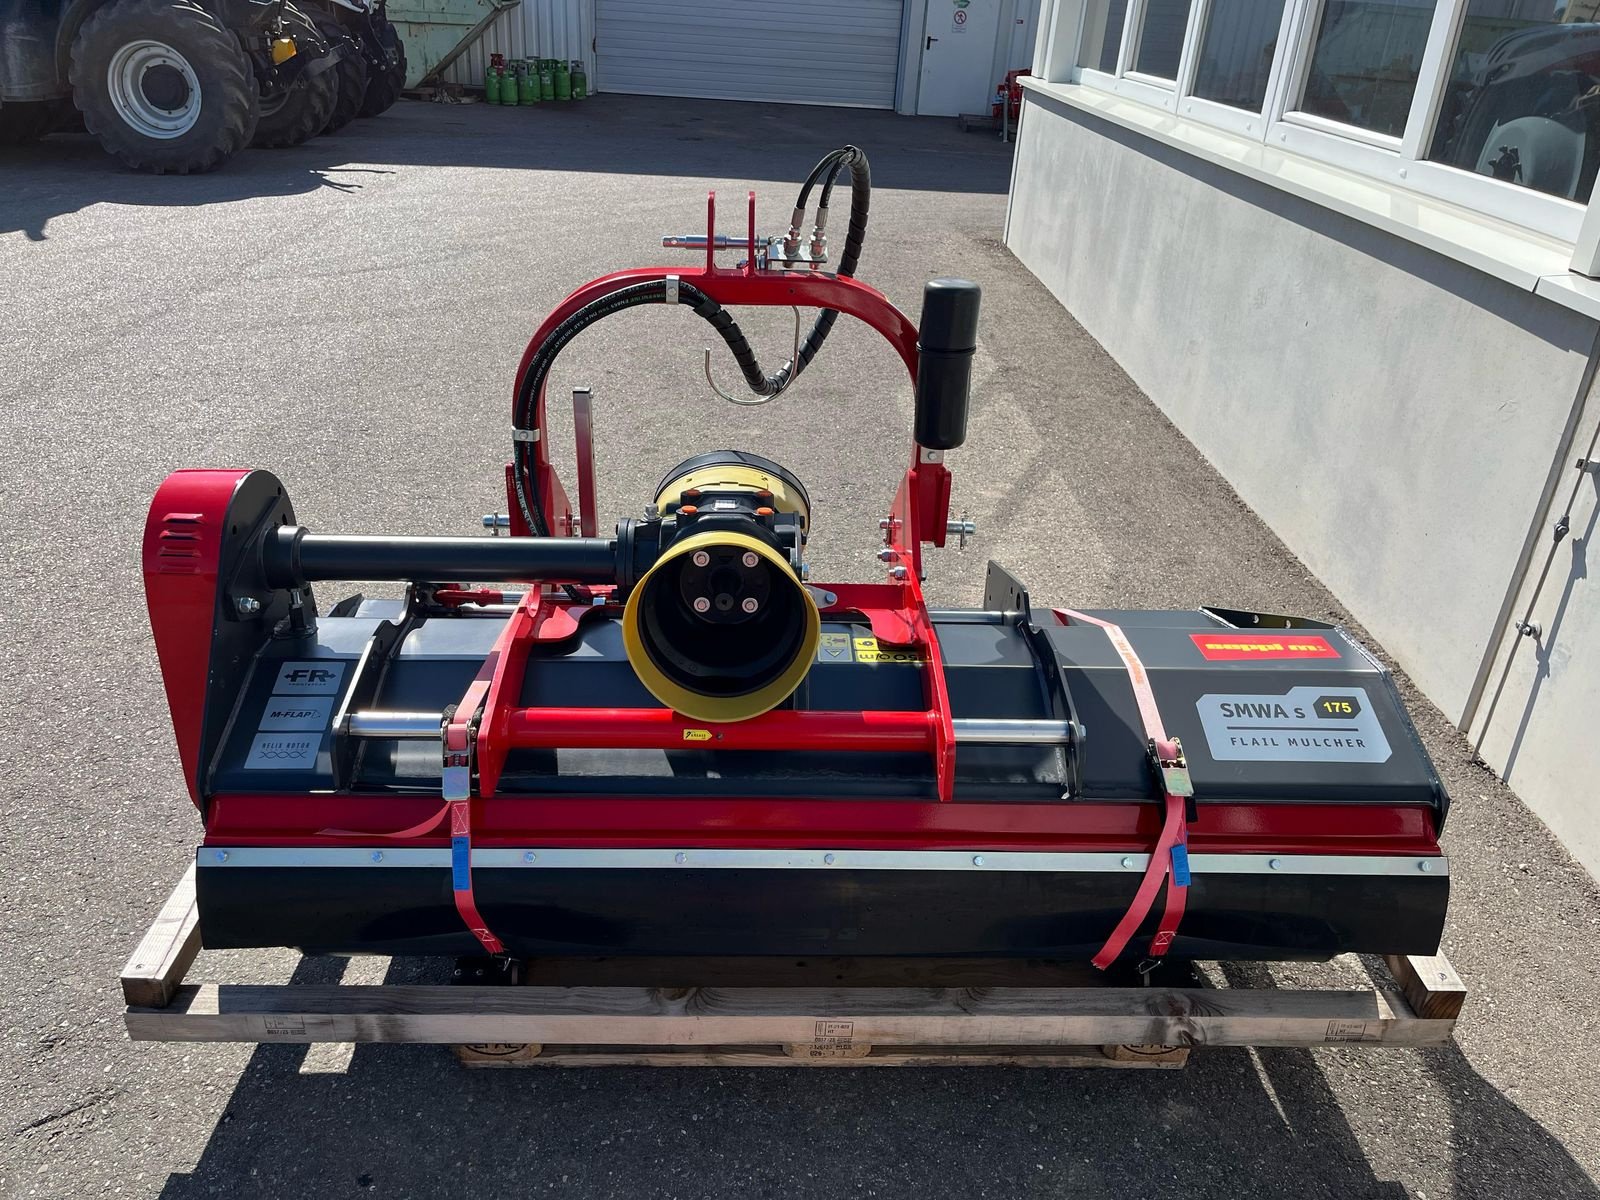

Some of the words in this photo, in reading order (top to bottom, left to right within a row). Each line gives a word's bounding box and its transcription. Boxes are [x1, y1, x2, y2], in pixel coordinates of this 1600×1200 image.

[1220, 703, 1290, 719] SMWA
[1323, 702, 1353, 714] 175
[1230, 737, 1279, 747] FLAIL
[1288, 737, 1367, 748] MULCHER
